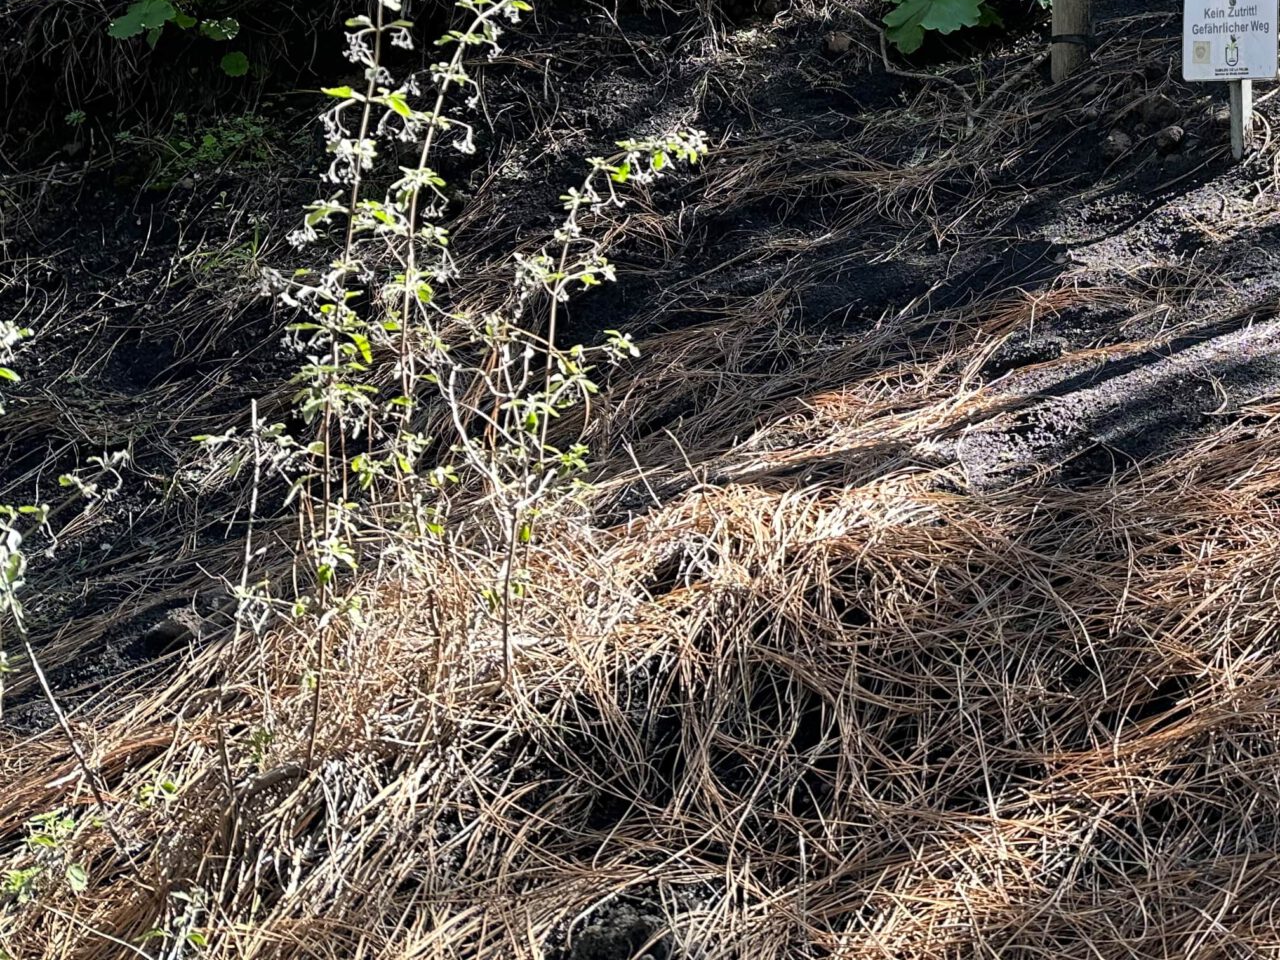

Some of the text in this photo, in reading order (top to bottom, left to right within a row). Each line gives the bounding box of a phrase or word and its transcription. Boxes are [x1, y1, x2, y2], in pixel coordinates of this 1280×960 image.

[1204, 6, 1257, 19] Kein Zutritt!
[1192, 21, 1269, 35] Gefährlicher Weg
